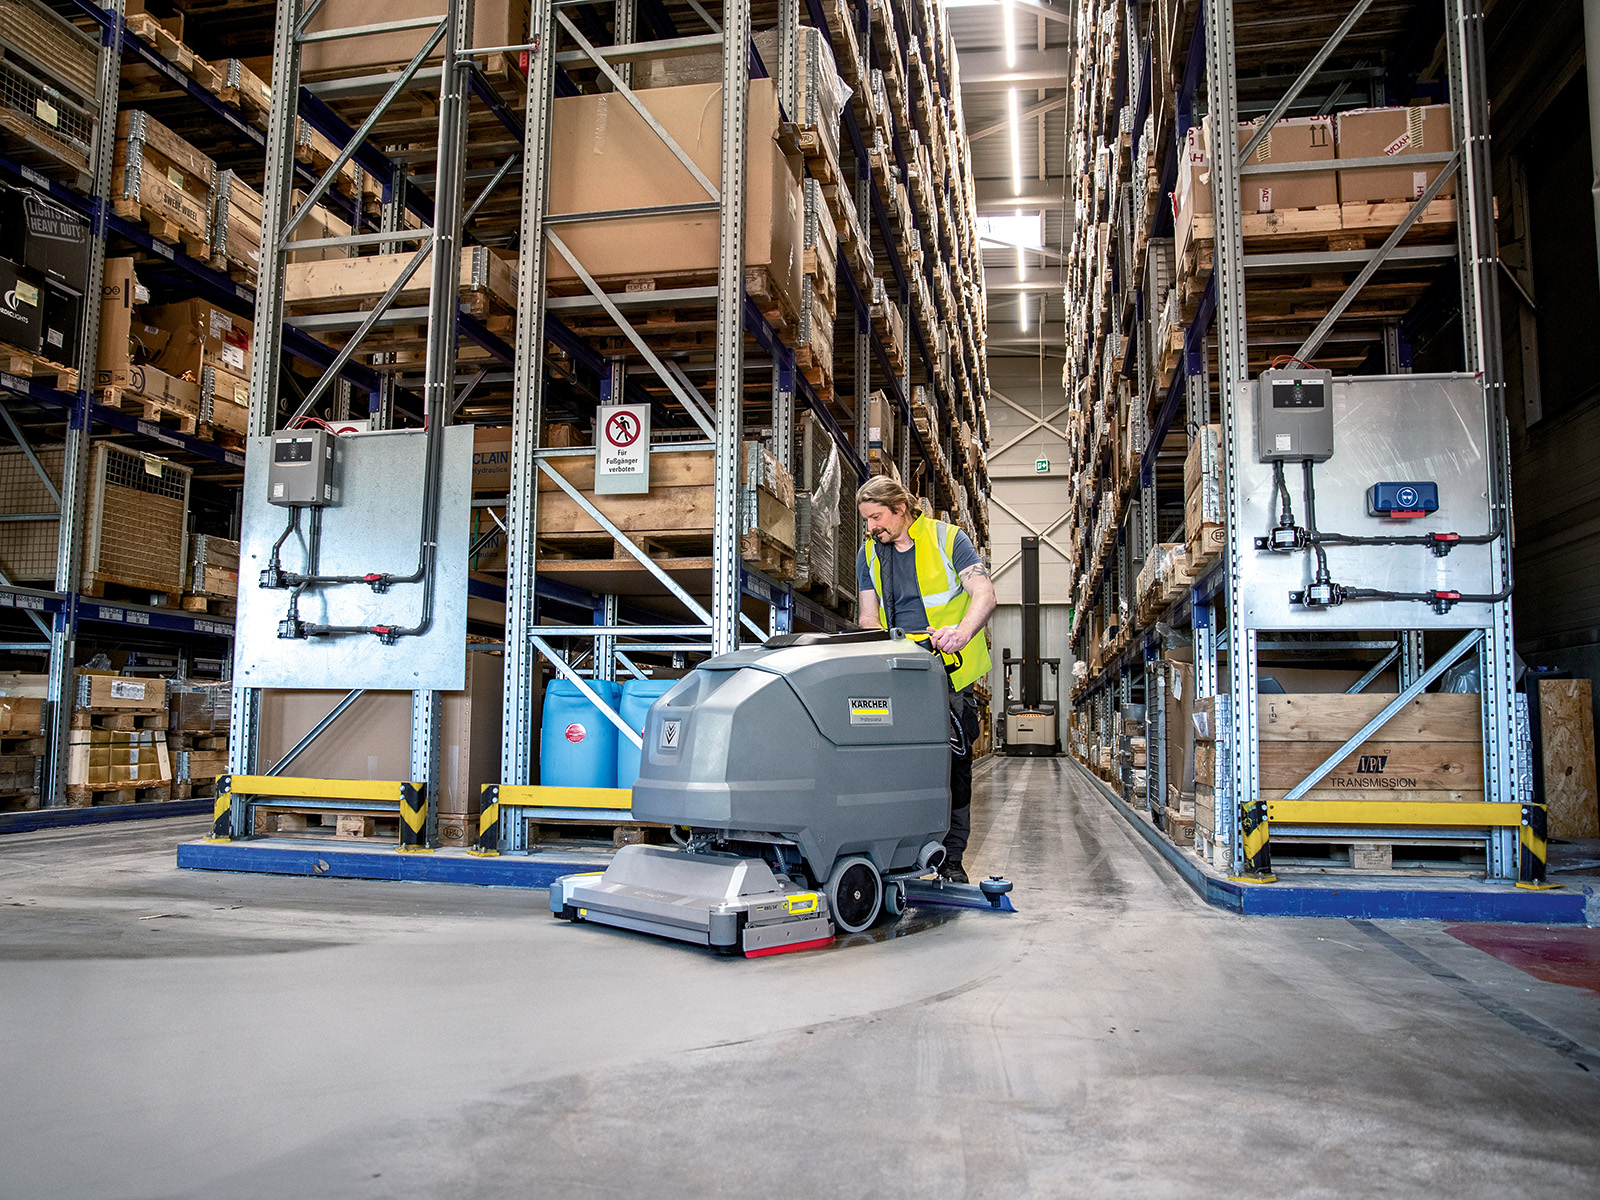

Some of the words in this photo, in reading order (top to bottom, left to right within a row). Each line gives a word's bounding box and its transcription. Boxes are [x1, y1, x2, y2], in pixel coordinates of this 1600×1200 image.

[30, 217, 58, 233] HEAVY
[473, 451, 508, 464] CLAIN
[473, 466, 507, 475] Hydraulics
[1360, 757, 1386, 772] IPL
[1330, 778, 1416, 788] TRANSMISSION
